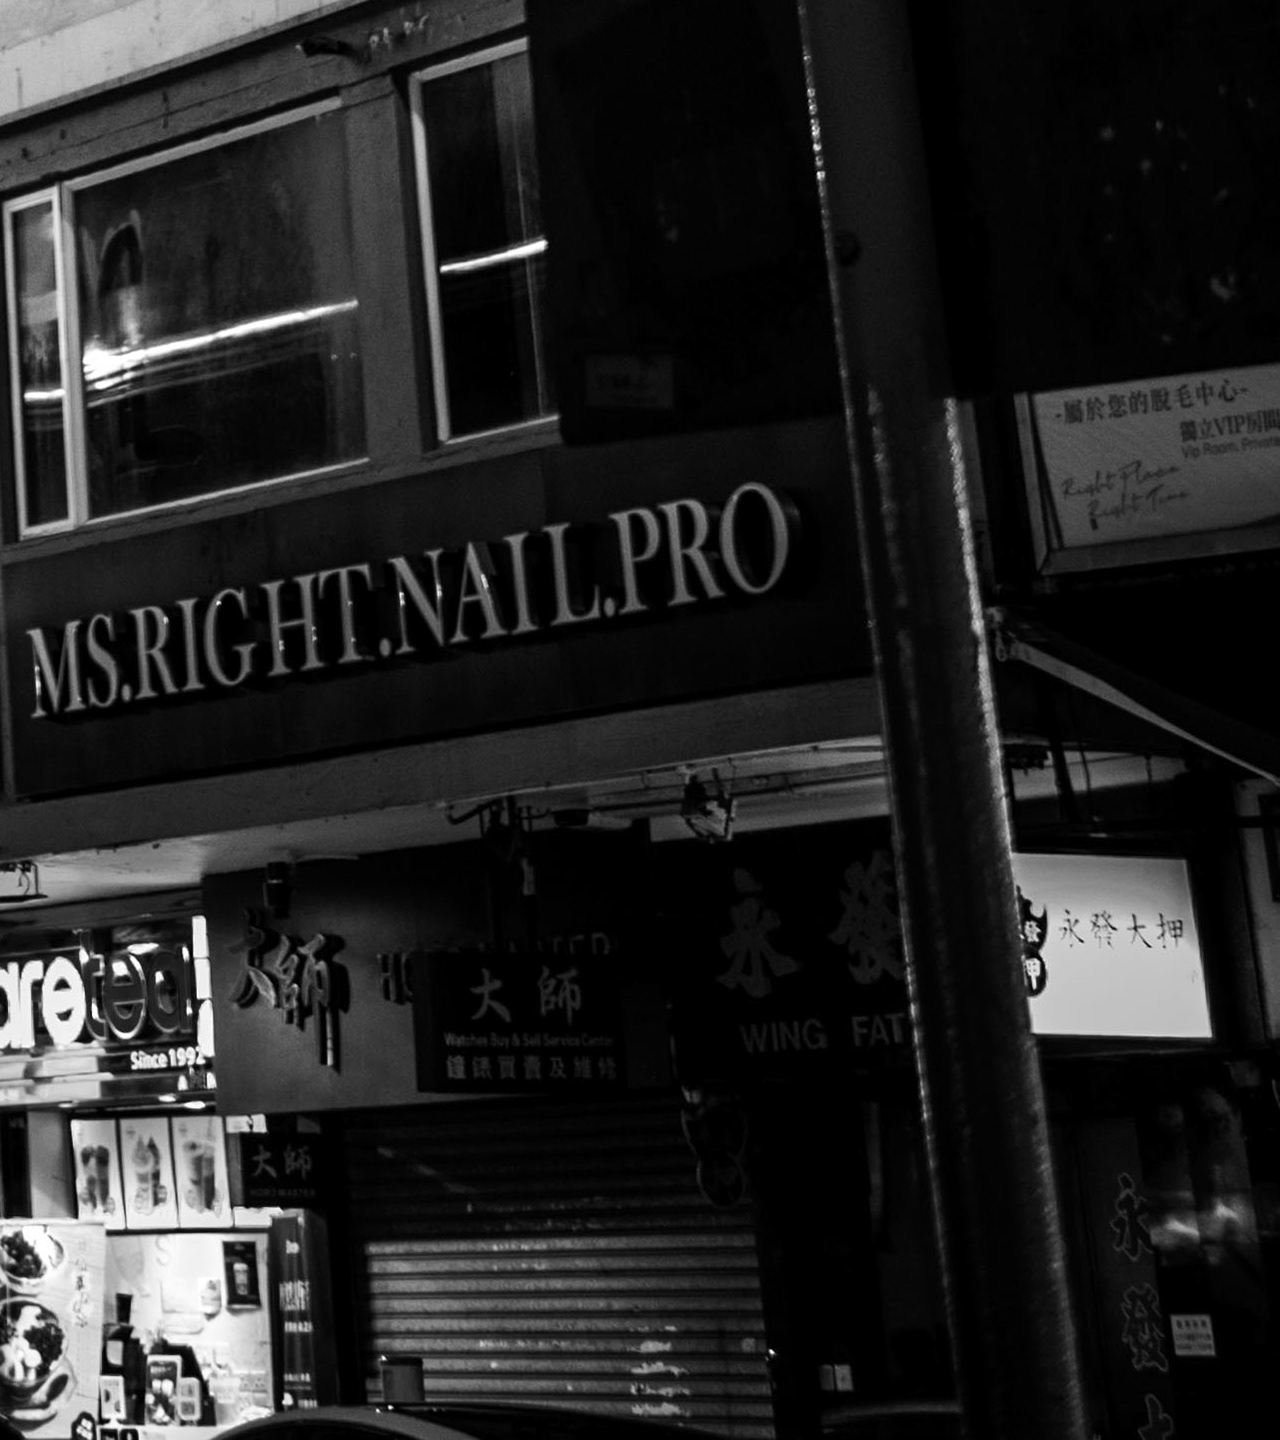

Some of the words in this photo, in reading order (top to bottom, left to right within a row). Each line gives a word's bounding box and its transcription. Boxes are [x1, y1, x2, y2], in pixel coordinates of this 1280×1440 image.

[1058, 908, 1184, 949] 永發大押
[468, 964, 583, 1029] 大師
[739, 1017, 829, 1055] WING
[850, 1011, 905, 1048] FAT
[130, 1051, 169, 1069] Since
[169, 1046, 206, 1067] 1992
[249, 1142, 314, 1180] 大師
